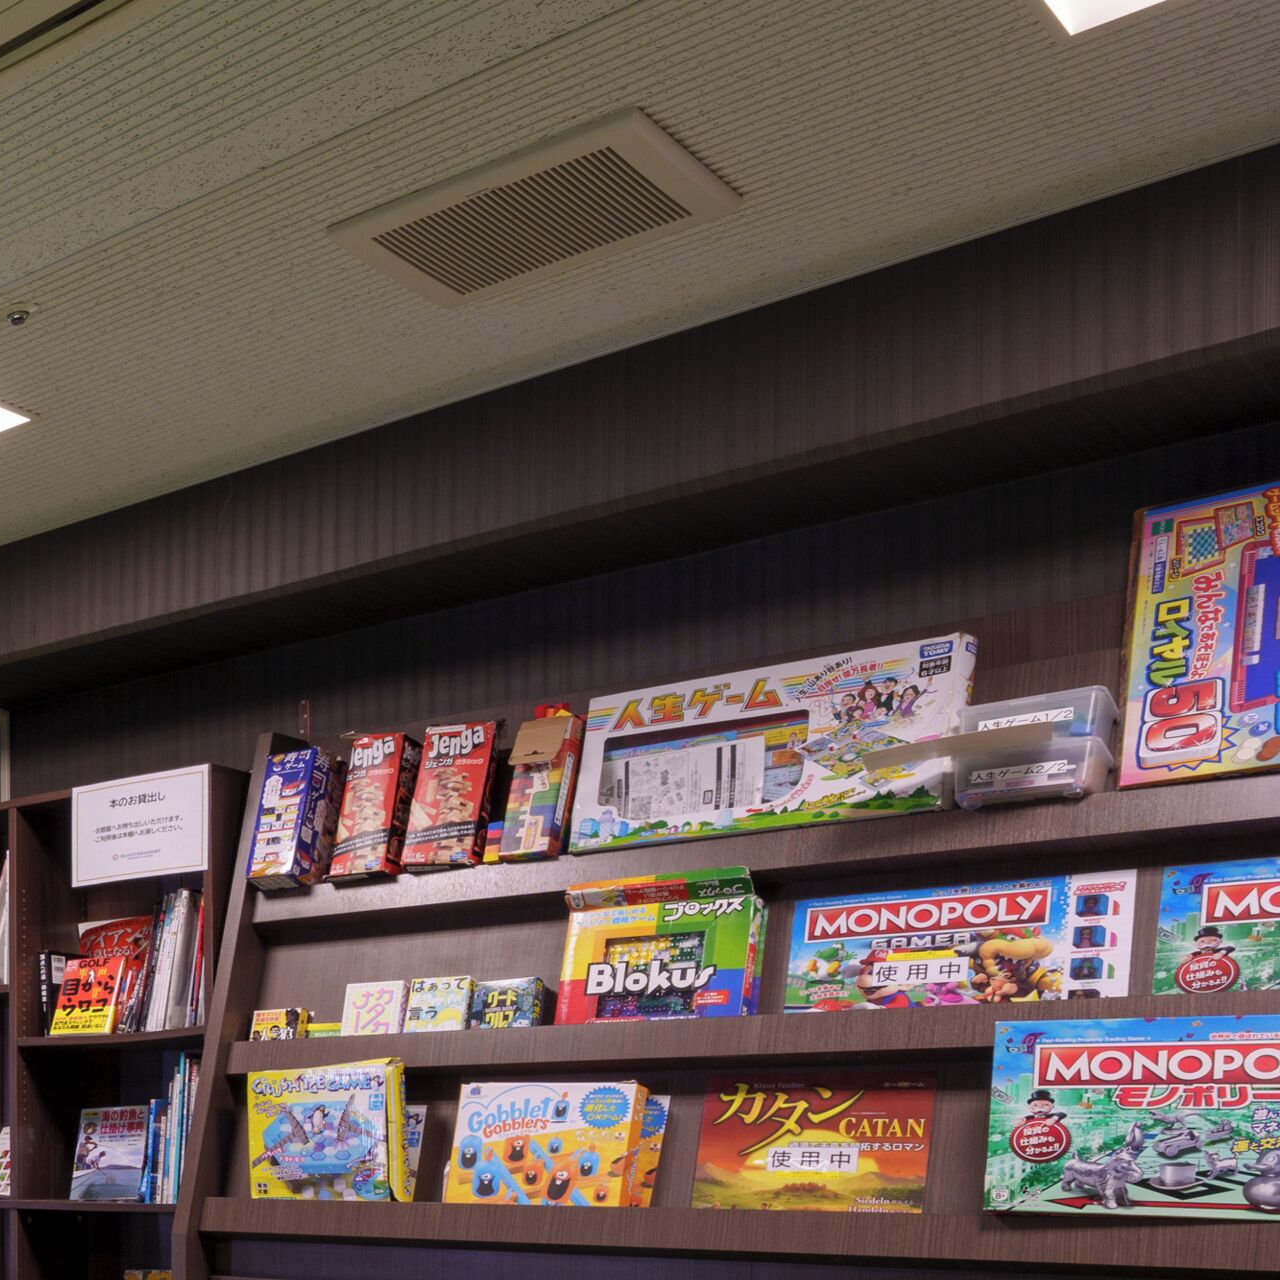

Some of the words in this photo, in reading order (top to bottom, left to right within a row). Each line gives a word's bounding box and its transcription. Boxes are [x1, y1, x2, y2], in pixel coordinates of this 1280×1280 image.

[609, 677, 783, 732] 人生ゲーム
[429, 726, 485, 758] Jenga
[284, 749, 312, 762] 寿司
[284, 761, 306, 769] ゲーム
[425, 758, 453, 769] ジェンガ
[109, 791, 166, 808] 本のお貸出し
[663, 897, 746, 922] ブロックス
[813, 894, 1043, 936] MONOPOLY
[871, 933, 970, 951] GAMER
[78, 957, 111, 968] GOLF
[875, 961, 961, 983] 使用中
[411, 976, 468, 994] はぁって
[586, 959, 716, 995] Blokus
[62, 998, 108, 1017] ウロコ
[408, 1007, 438, 1021] 言う
[1045, 1047, 1280, 1081] MONOPO
[252, 1076, 300, 1098] CRUSH
[327, 1073, 372, 1092] GAME
[468, 1096, 554, 1133] Gobblet
[713, 1083, 865, 1155] カタン
[483, 1118, 550, 1139] Gobblers
[839, 1118, 926, 1137] CATAN
[771, 1151, 851, 1169] 使用中
[856, 1196, 890, 1205] Siedeln
